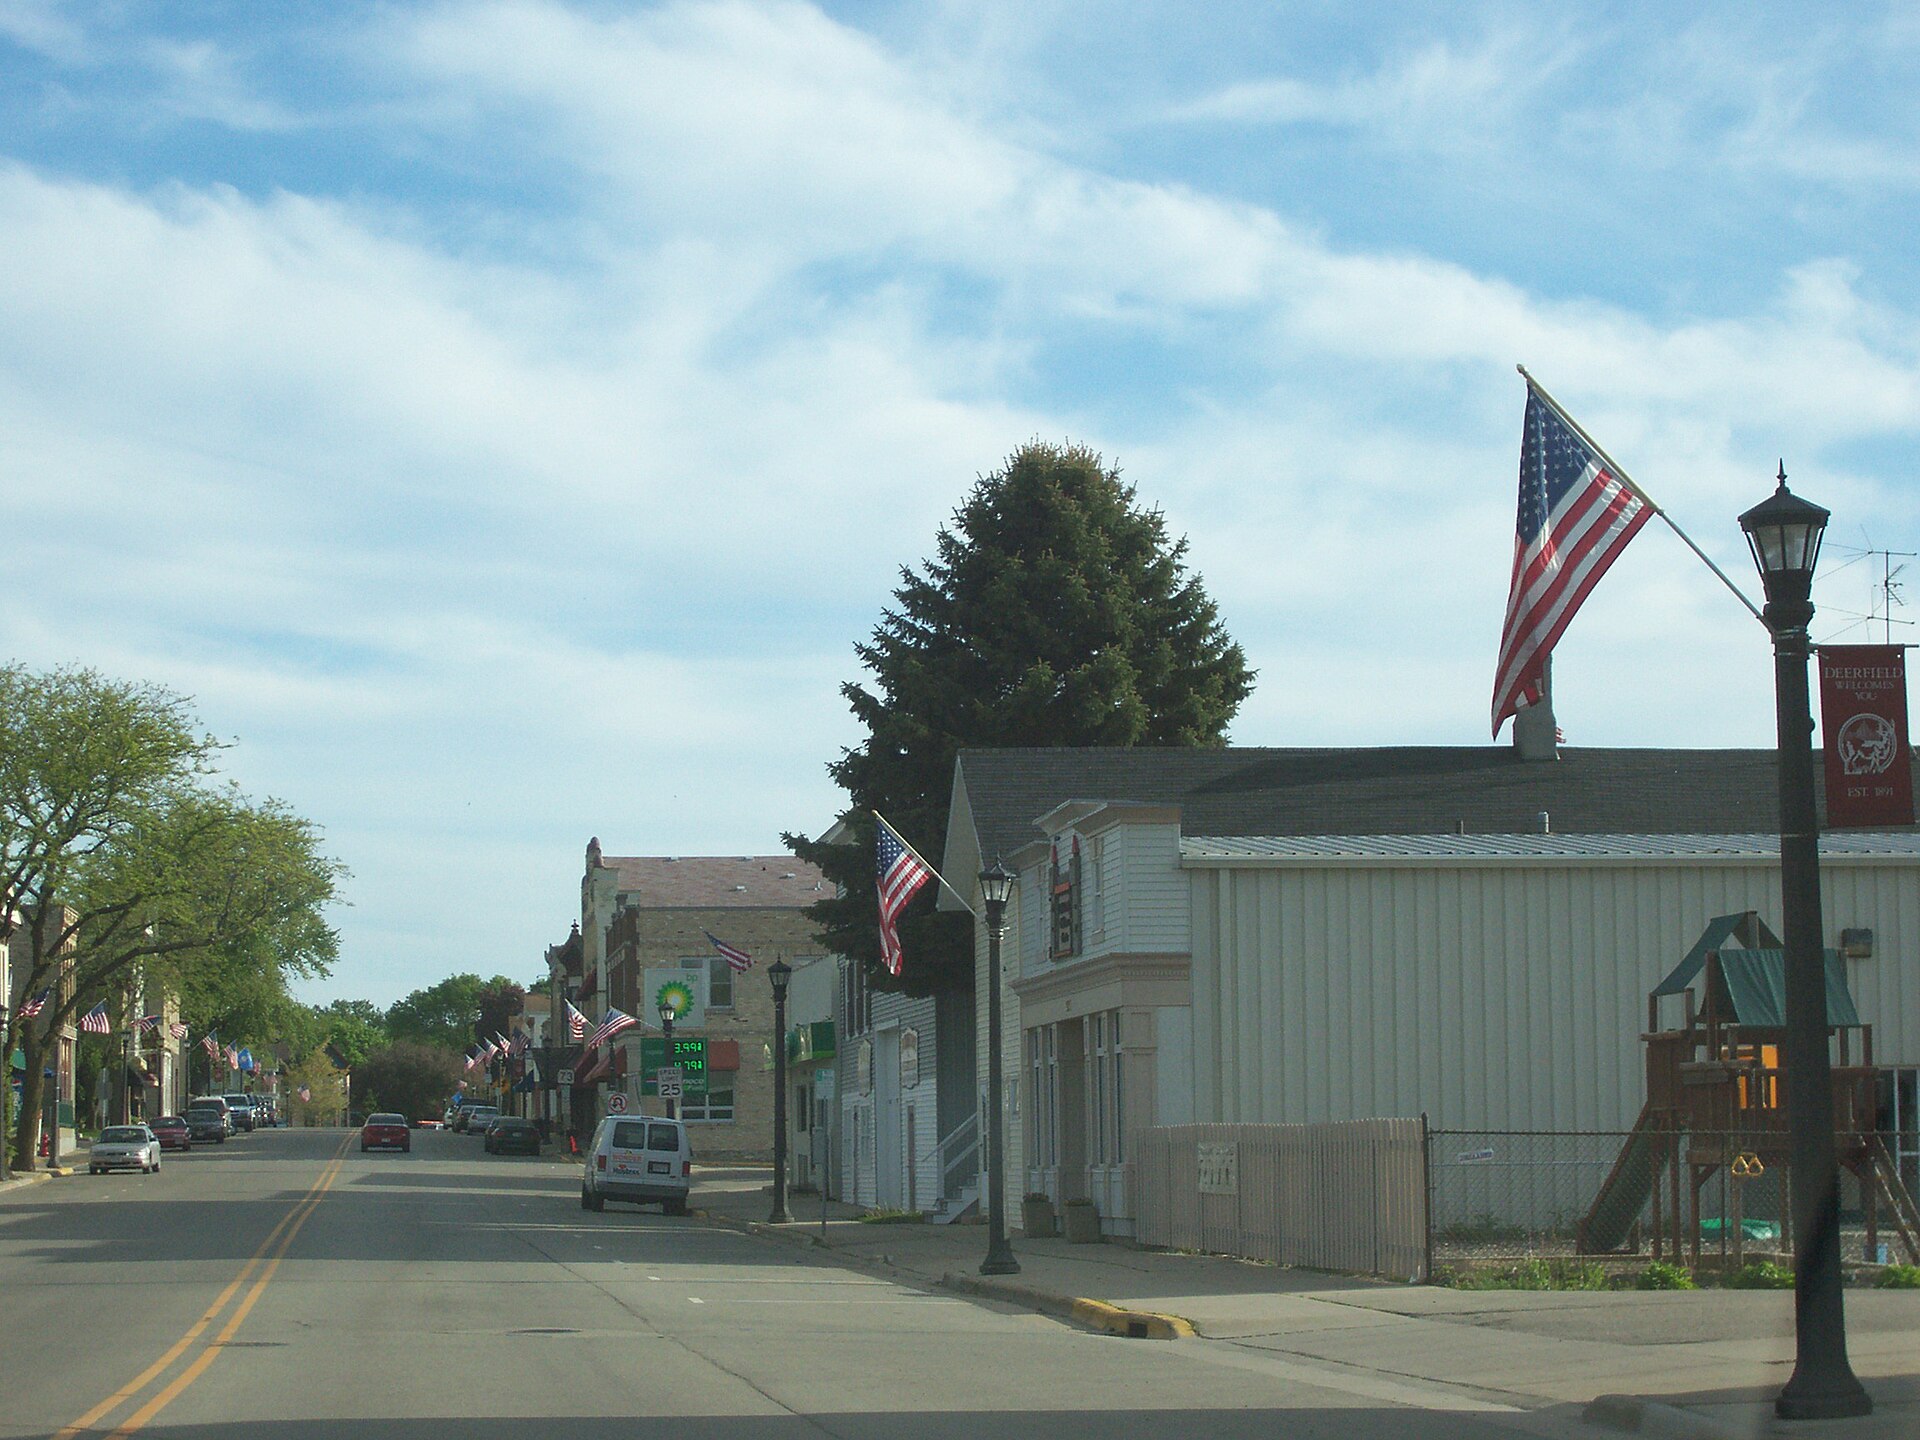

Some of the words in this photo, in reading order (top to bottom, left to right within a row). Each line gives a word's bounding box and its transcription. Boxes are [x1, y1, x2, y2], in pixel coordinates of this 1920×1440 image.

[1824, 667, 1904, 679] DEERFIELD
[1834, 680, 1895, 690] WELCOMES
[1855, 691, 1878, 701] YOU
[686, 973, 698, 983] bp
[559, 1071, 574, 1082] 73
[659, 1068, 681, 1076] SPEED
[660, 1083, 681, 1097] 25
